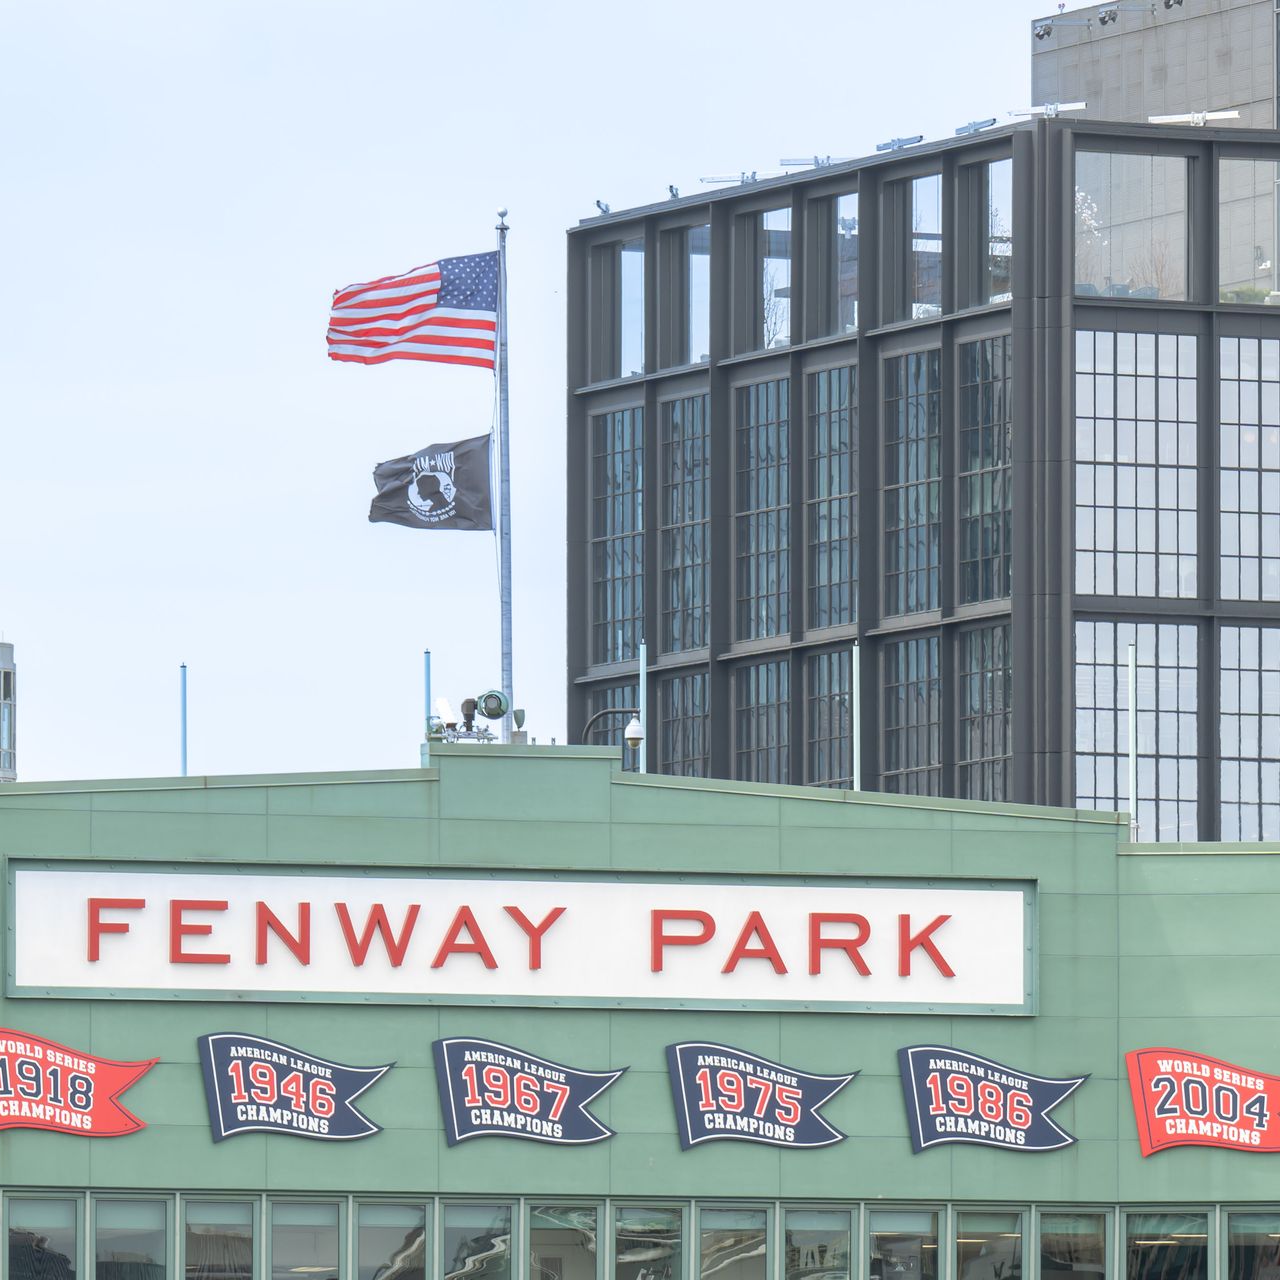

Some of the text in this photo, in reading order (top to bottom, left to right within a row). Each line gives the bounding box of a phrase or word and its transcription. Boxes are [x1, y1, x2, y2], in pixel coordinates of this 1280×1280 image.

[86, 896, 956, 978] FENWAY PARK
[46, 1050, 95, 1074] SERIES
[230, 1046, 332, 1078] AMERICAN LEAGUE
[465, 1051, 566, 1082] AMERICAN LEAGUE
[698, 1055, 797, 1086] AMERICAN LEAGUE
[929, 1059, 1028, 1090] AMERICAN LEAGUE
[1157, 1060, 1264, 1090] WORLD SERIES
[228, 1060, 336, 1118] 1946
[462, 1064, 570, 1122] 1967
[696, 1068, 802, 1126] 1975
[926, 1072, 1033, 1130] 1986
[1151, 1075, 1269, 1131] 2004
[0, 1101, 91, 1129] CHAMPIONS
[237, 1105, 329, 1133] CHAMPIONS
[471, 1109, 562, 1138] CHAMPIONS
[704, 1114, 795, 1142] CHAMPIONS
[935, 1117, 1025, 1145] CHAMPIONS
[1166, 1119, 1260, 1145] CHAMPIONS
